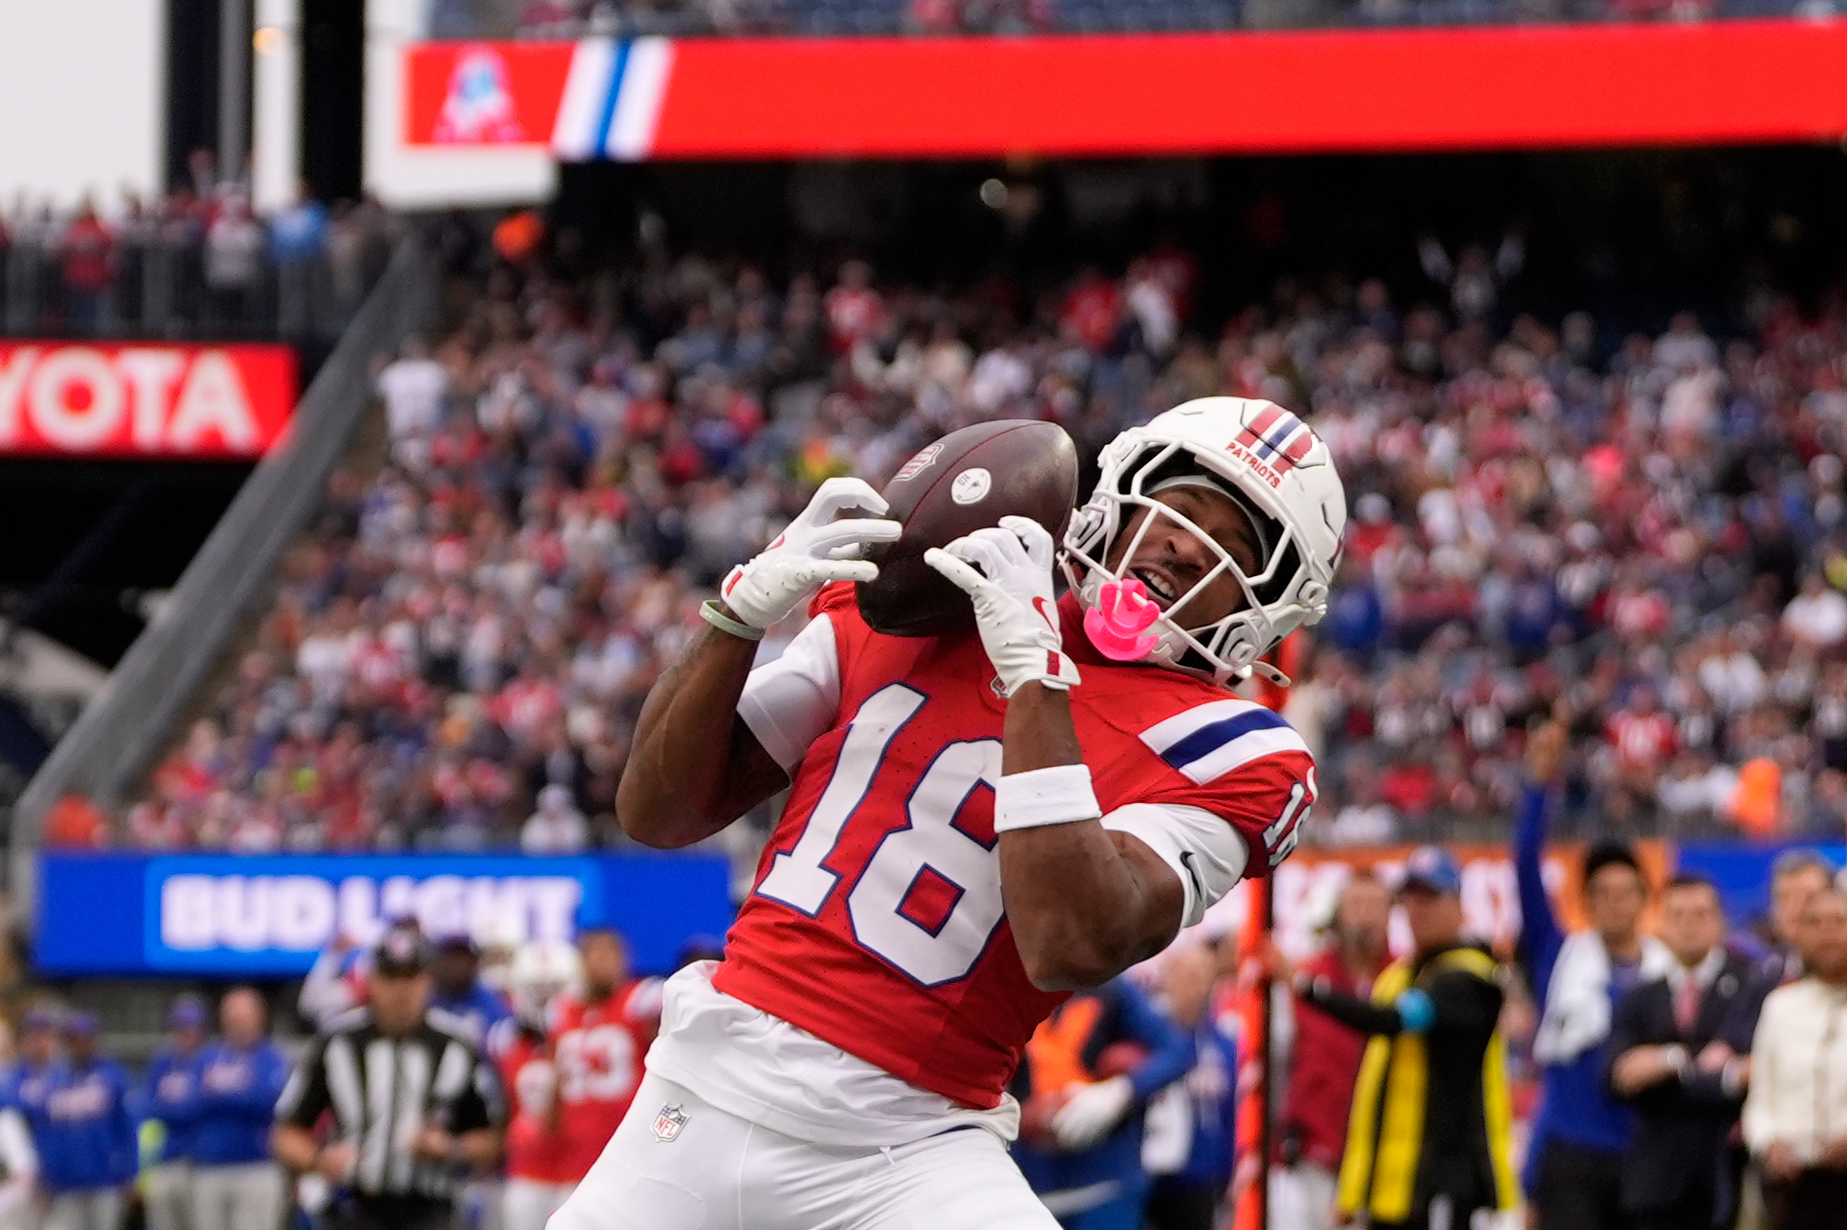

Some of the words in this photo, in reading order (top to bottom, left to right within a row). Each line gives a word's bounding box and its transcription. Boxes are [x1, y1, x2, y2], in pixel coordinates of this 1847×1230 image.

[1225, 442, 1280, 488] PATRIOTS
[757, 682, 1004, 987] 18
[159, 872, 337, 952] BUD
[338, 873, 581, 952] LIGHT
[656, 1117, 676, 1136] NFL
